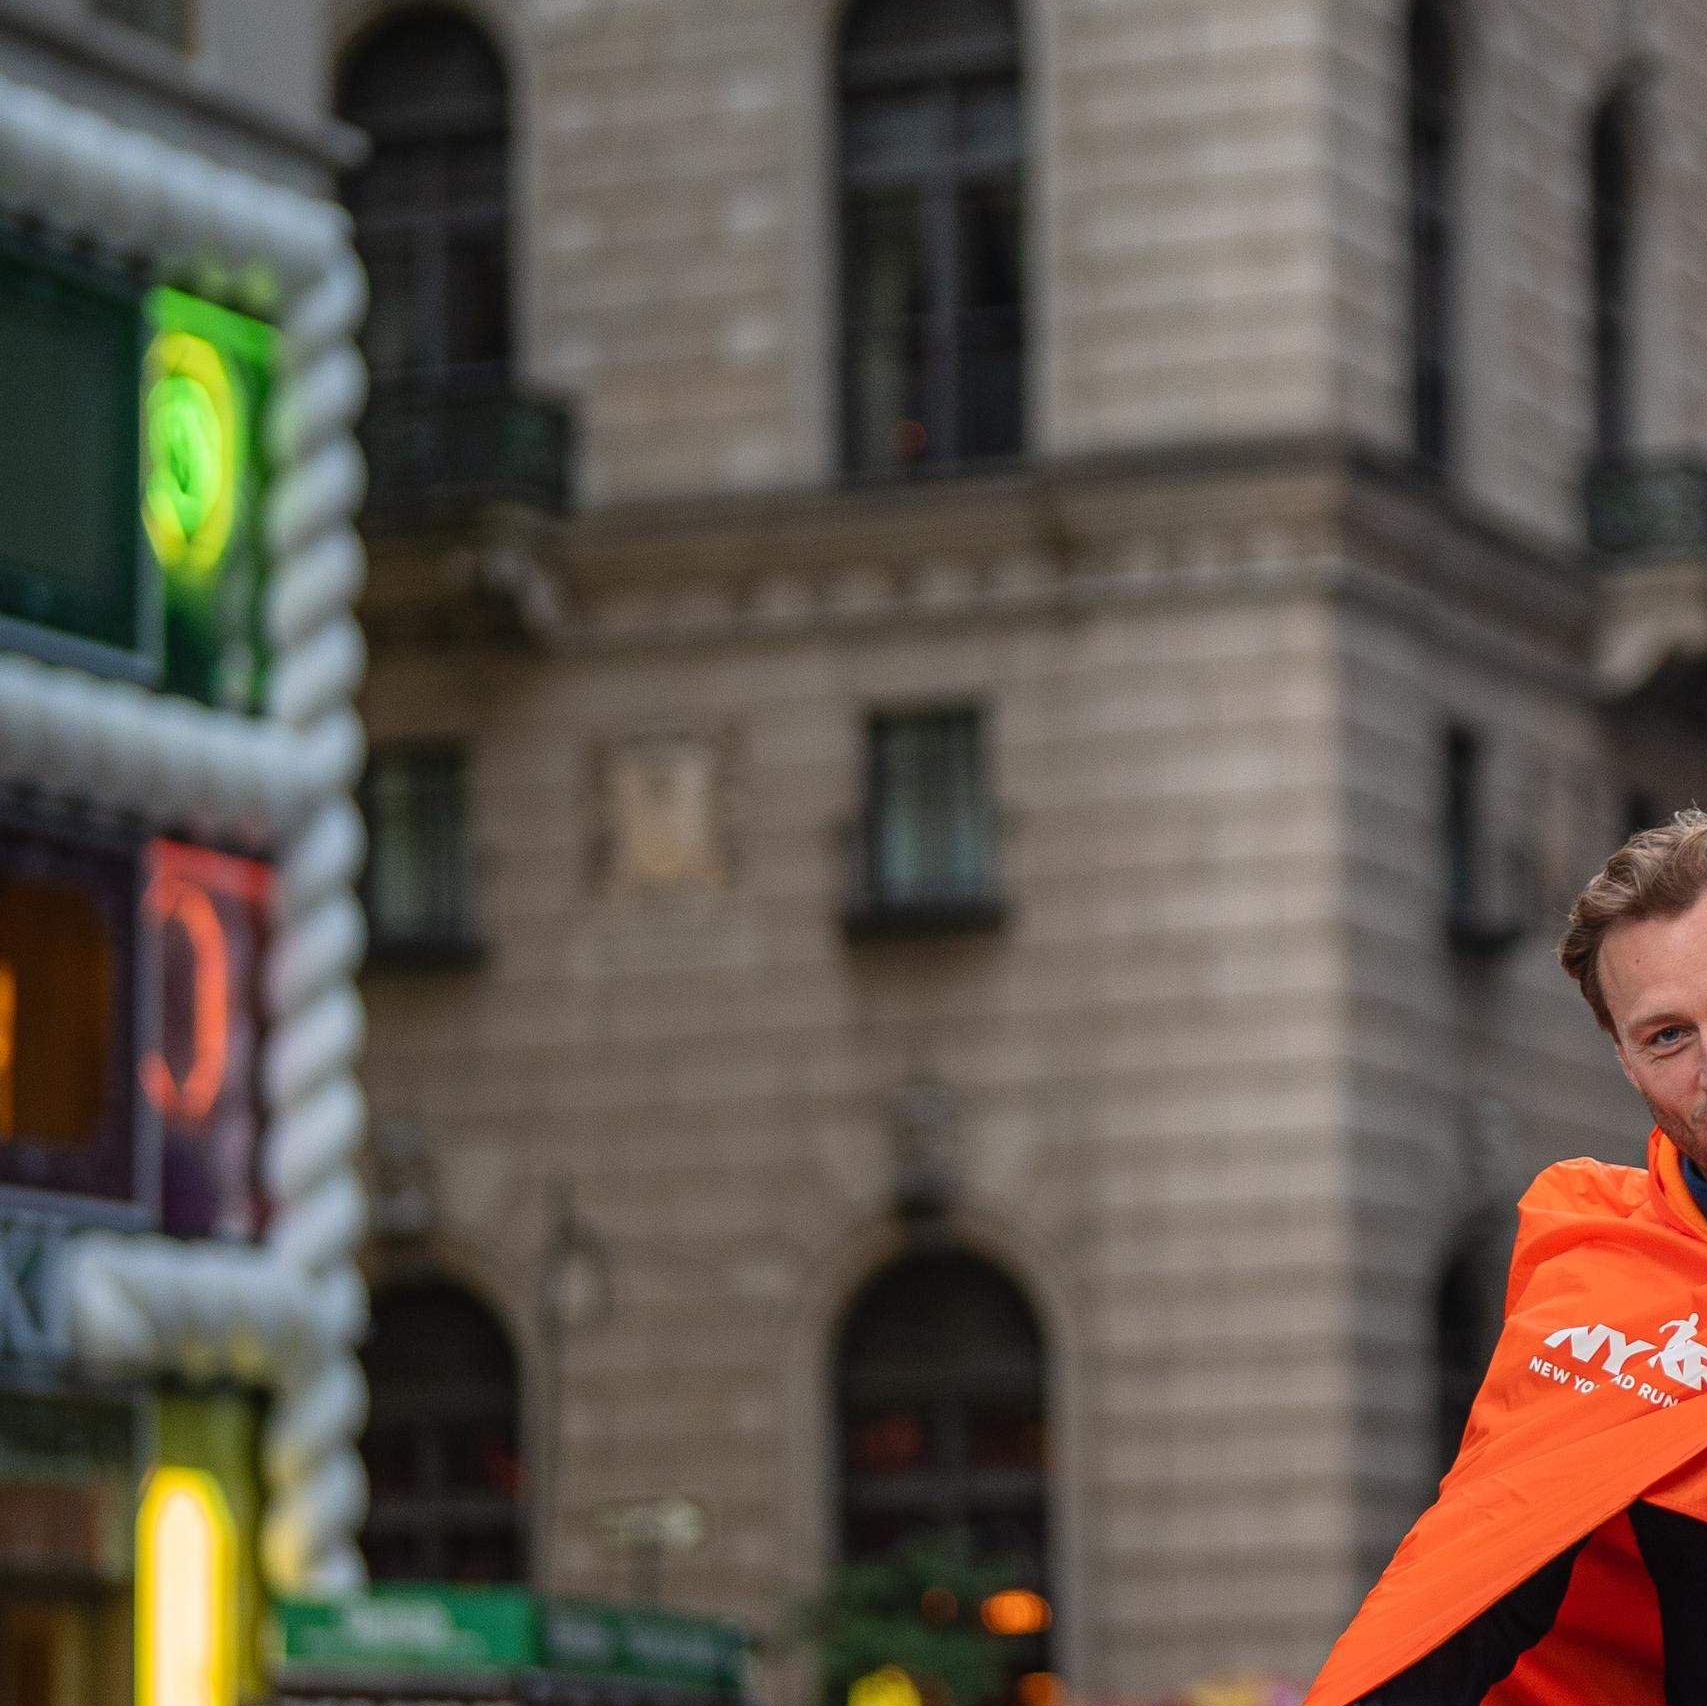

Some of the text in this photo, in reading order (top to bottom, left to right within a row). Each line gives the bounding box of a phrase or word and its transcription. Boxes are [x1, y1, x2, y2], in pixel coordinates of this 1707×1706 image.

[1529, 1355, 1571, 1384] NEW
[1574, 1374, 1600, 1393] YO
[1610, 1373, 1635, 1389] AD
